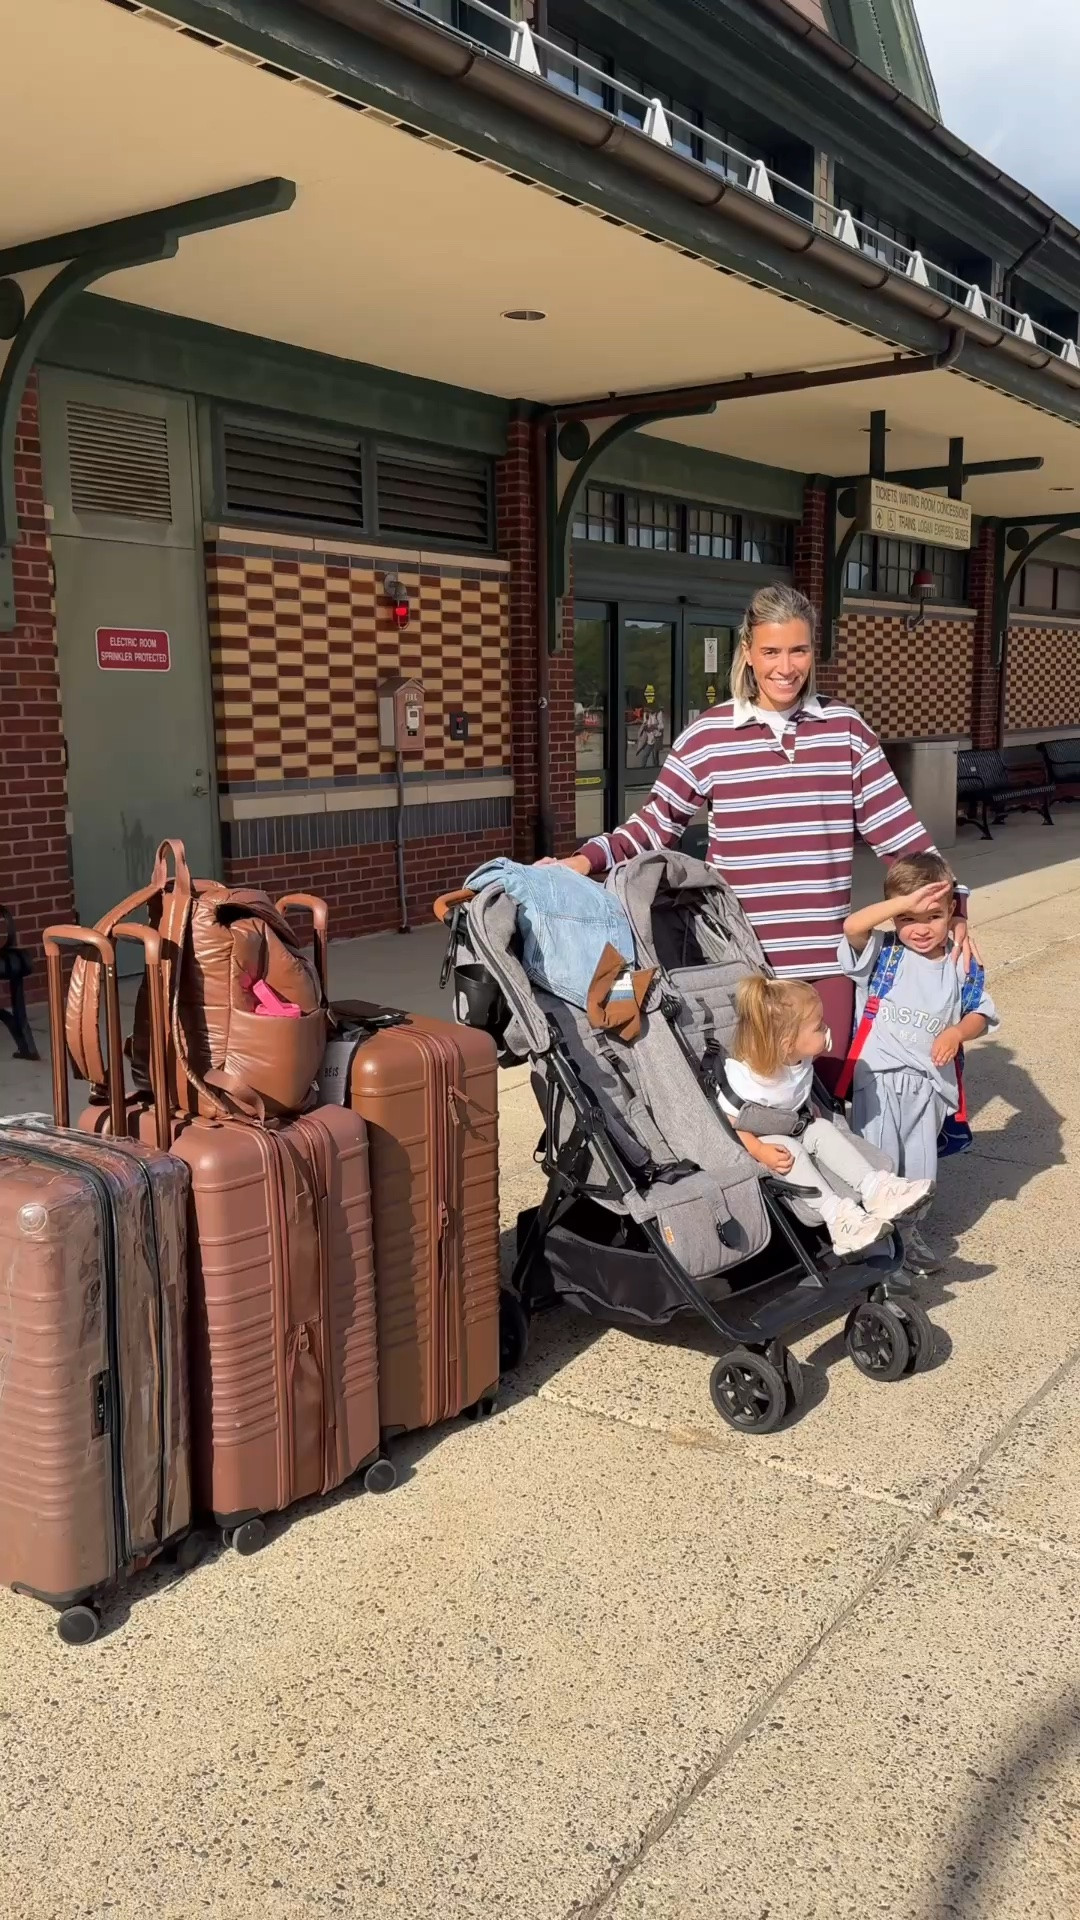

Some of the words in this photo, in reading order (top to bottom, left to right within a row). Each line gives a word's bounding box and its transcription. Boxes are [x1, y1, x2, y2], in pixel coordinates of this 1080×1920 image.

[899, 492, 919, 508] WAITING
[937, 501, 969, 520] CONCESSIONS
[918, 520, 933, 534] LOGAN
[934, 522, 953, 539] EXPRESS
[954, 528, 969, 542] BUSES
[110, 637, 137, 647] ELECTRIC
[139, 638, 156, 648] ROOM
[101, 651, 133, 662] SPRINKLER
[134, 653, 167, 663] PROTECTED
